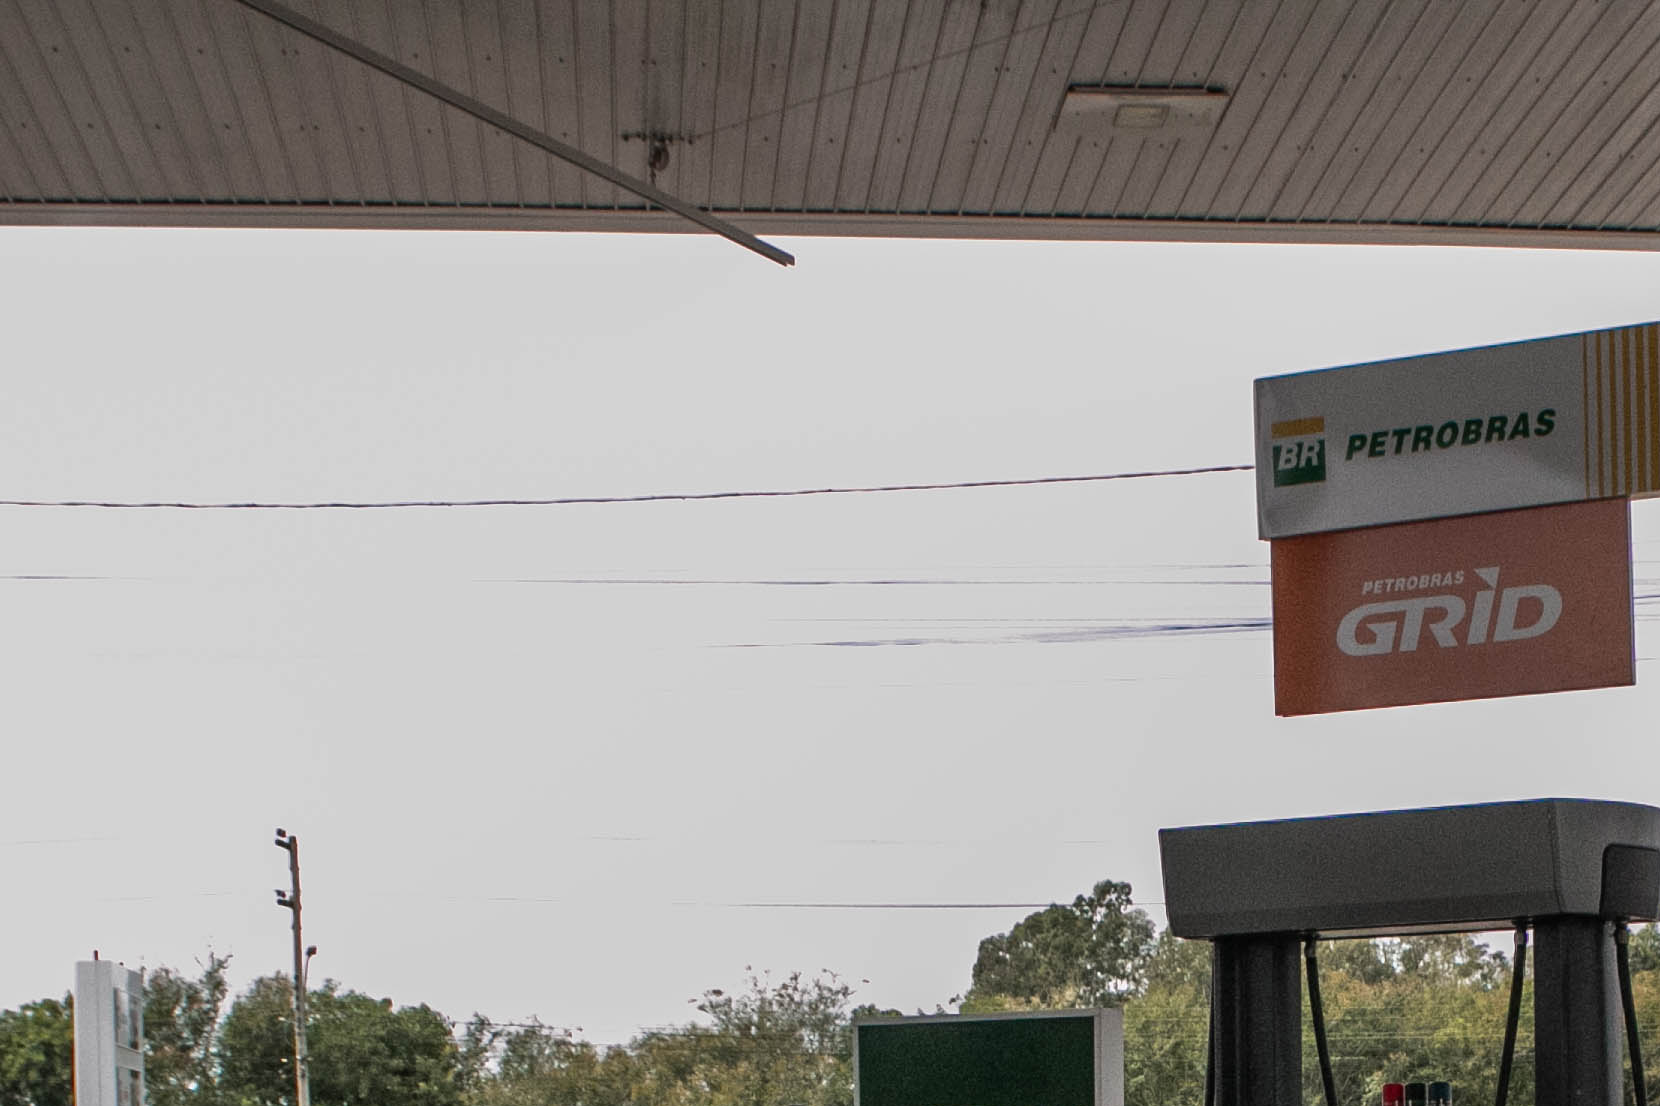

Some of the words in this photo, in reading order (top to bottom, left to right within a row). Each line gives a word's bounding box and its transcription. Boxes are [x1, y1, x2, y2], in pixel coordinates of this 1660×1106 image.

[1273, 438, 1322, 471] BR
[1345, 407, 1557, 462] PETROBRAS
[1335, 567, 1564, 657] GRID
[1361, 569, 1466, 596] PETROBRAS
